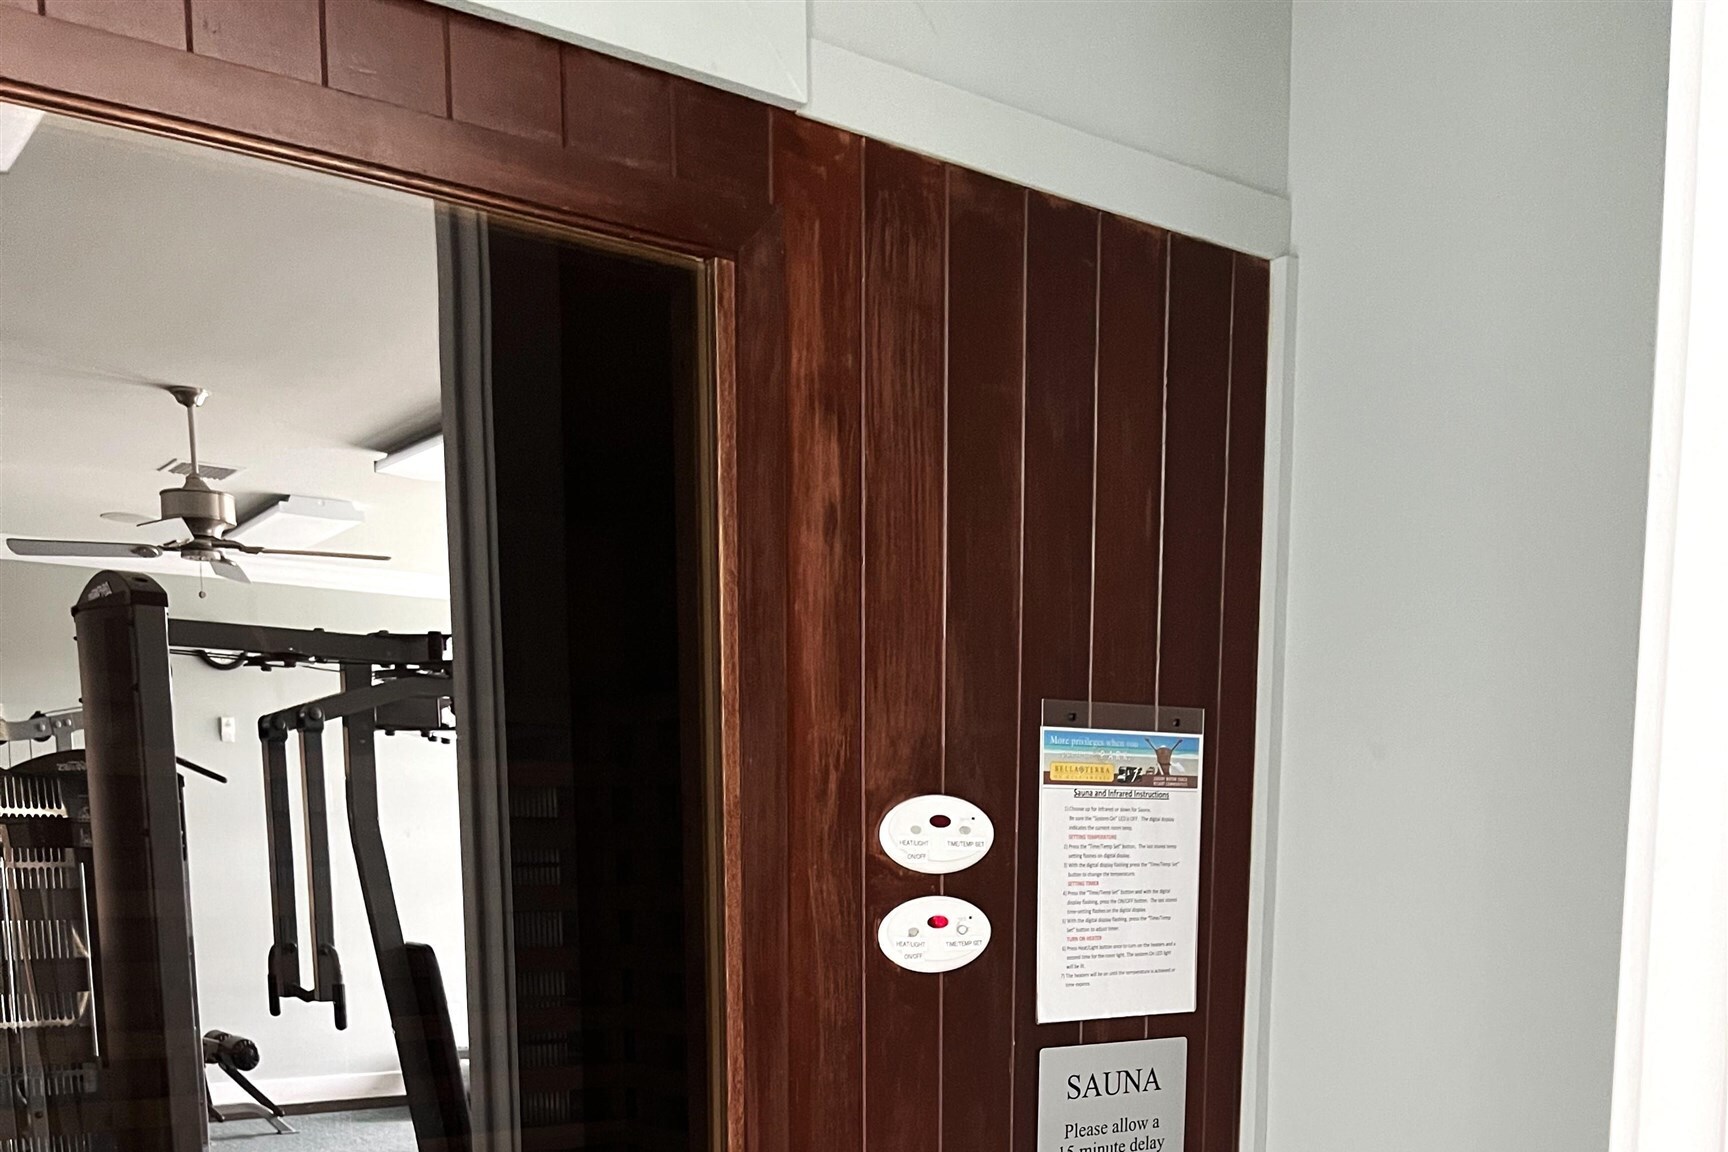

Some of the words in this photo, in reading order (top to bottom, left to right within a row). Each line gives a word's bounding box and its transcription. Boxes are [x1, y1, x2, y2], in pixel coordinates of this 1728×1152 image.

[1050, 735, 1070, 745] More
[1073, 788, 1093, 798] Sauna
[1094, 789, 1107, 798] and
[1107, 789, 1133, 799] Infrared
[1133, 790, 1170, 800] Instructions
[1067, 1067, 1162, 1100] SAUNA
[1064, 1122, 1108, 1140] Please
[1112, 1117, 1149, 1134] allow
[1152, 1117, 1160, 1129] a
[1129, 1135, 1165, 1152] delay
